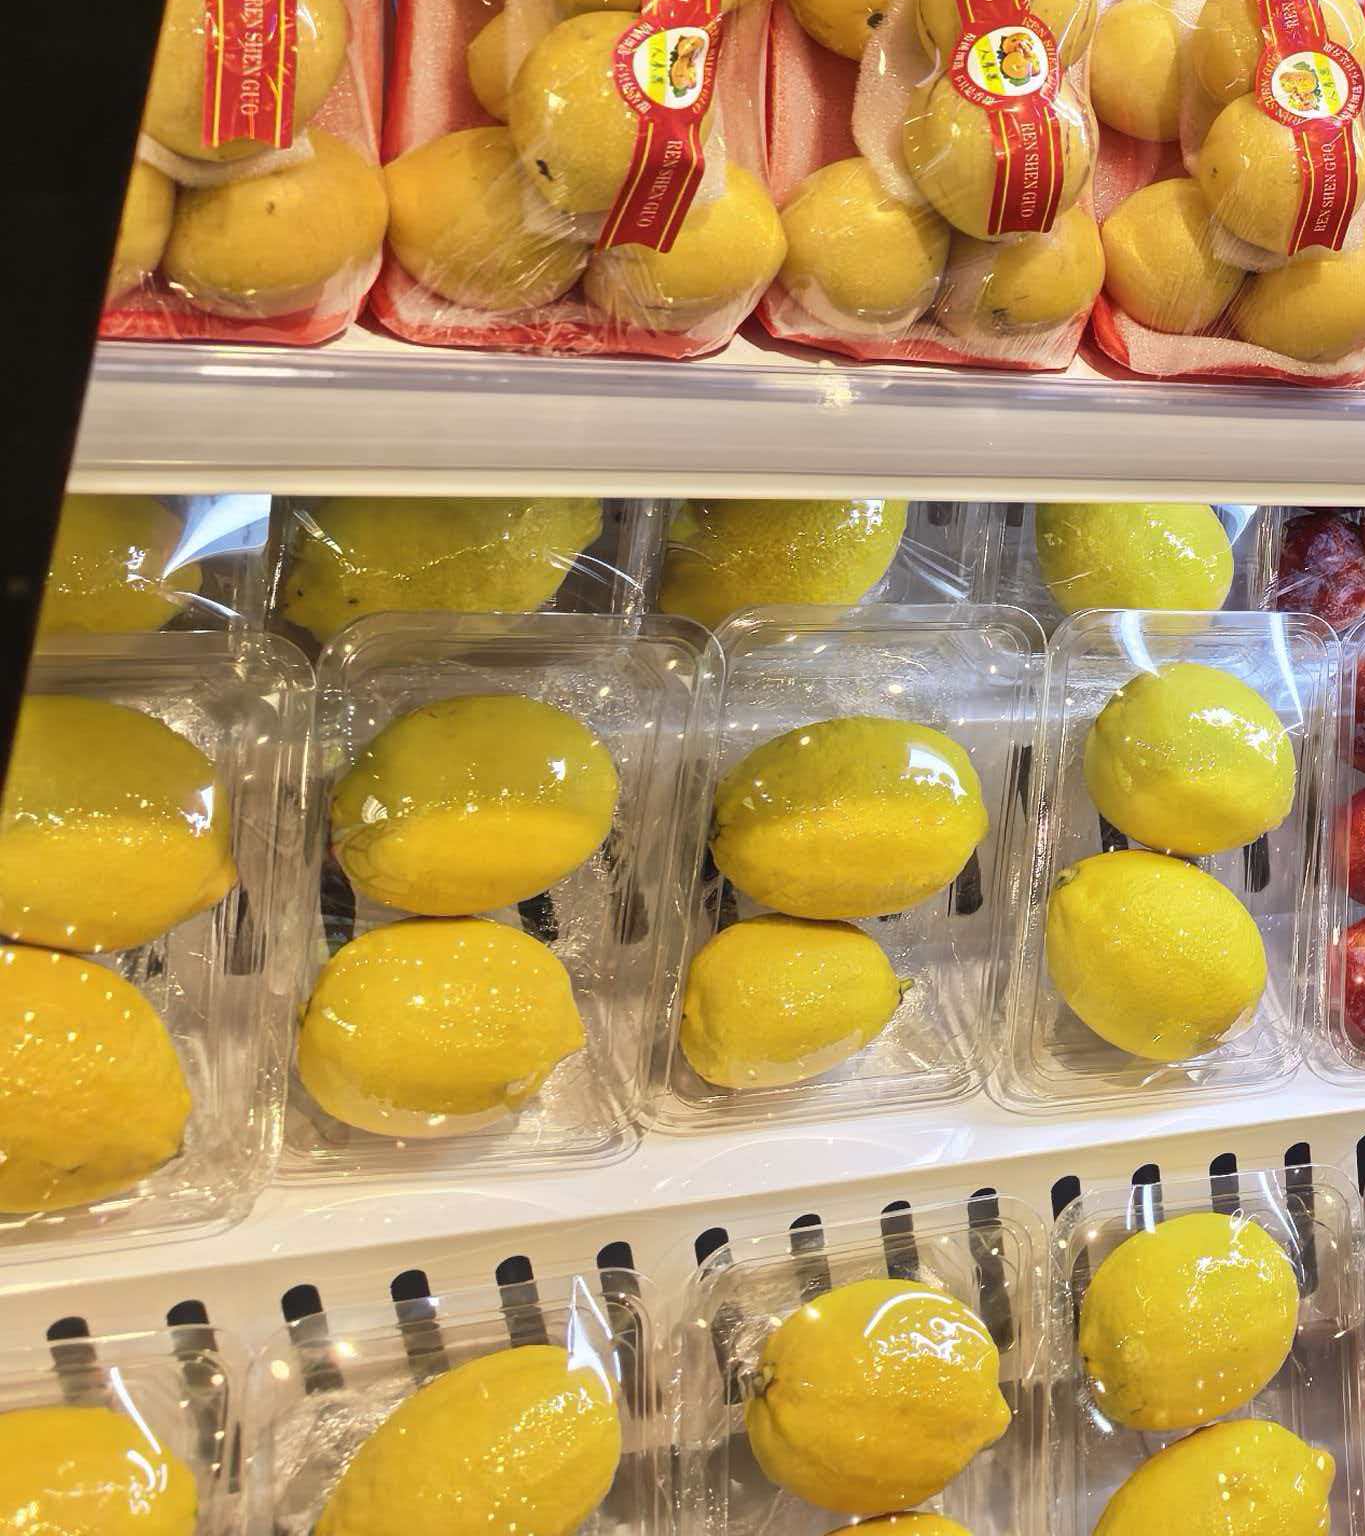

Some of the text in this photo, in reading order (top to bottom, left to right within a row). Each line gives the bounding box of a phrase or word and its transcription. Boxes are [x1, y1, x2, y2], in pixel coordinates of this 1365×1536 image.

[240, 79, 260, 115] GUO
[242, 32, 264, 77] SHEN
[638, 140, 683, 228] REN SHEN GUO
[1020, 122, 1039, 218] REN SHEN GUO
[1314, 144, 1337, 232] REN SHEN GUO
